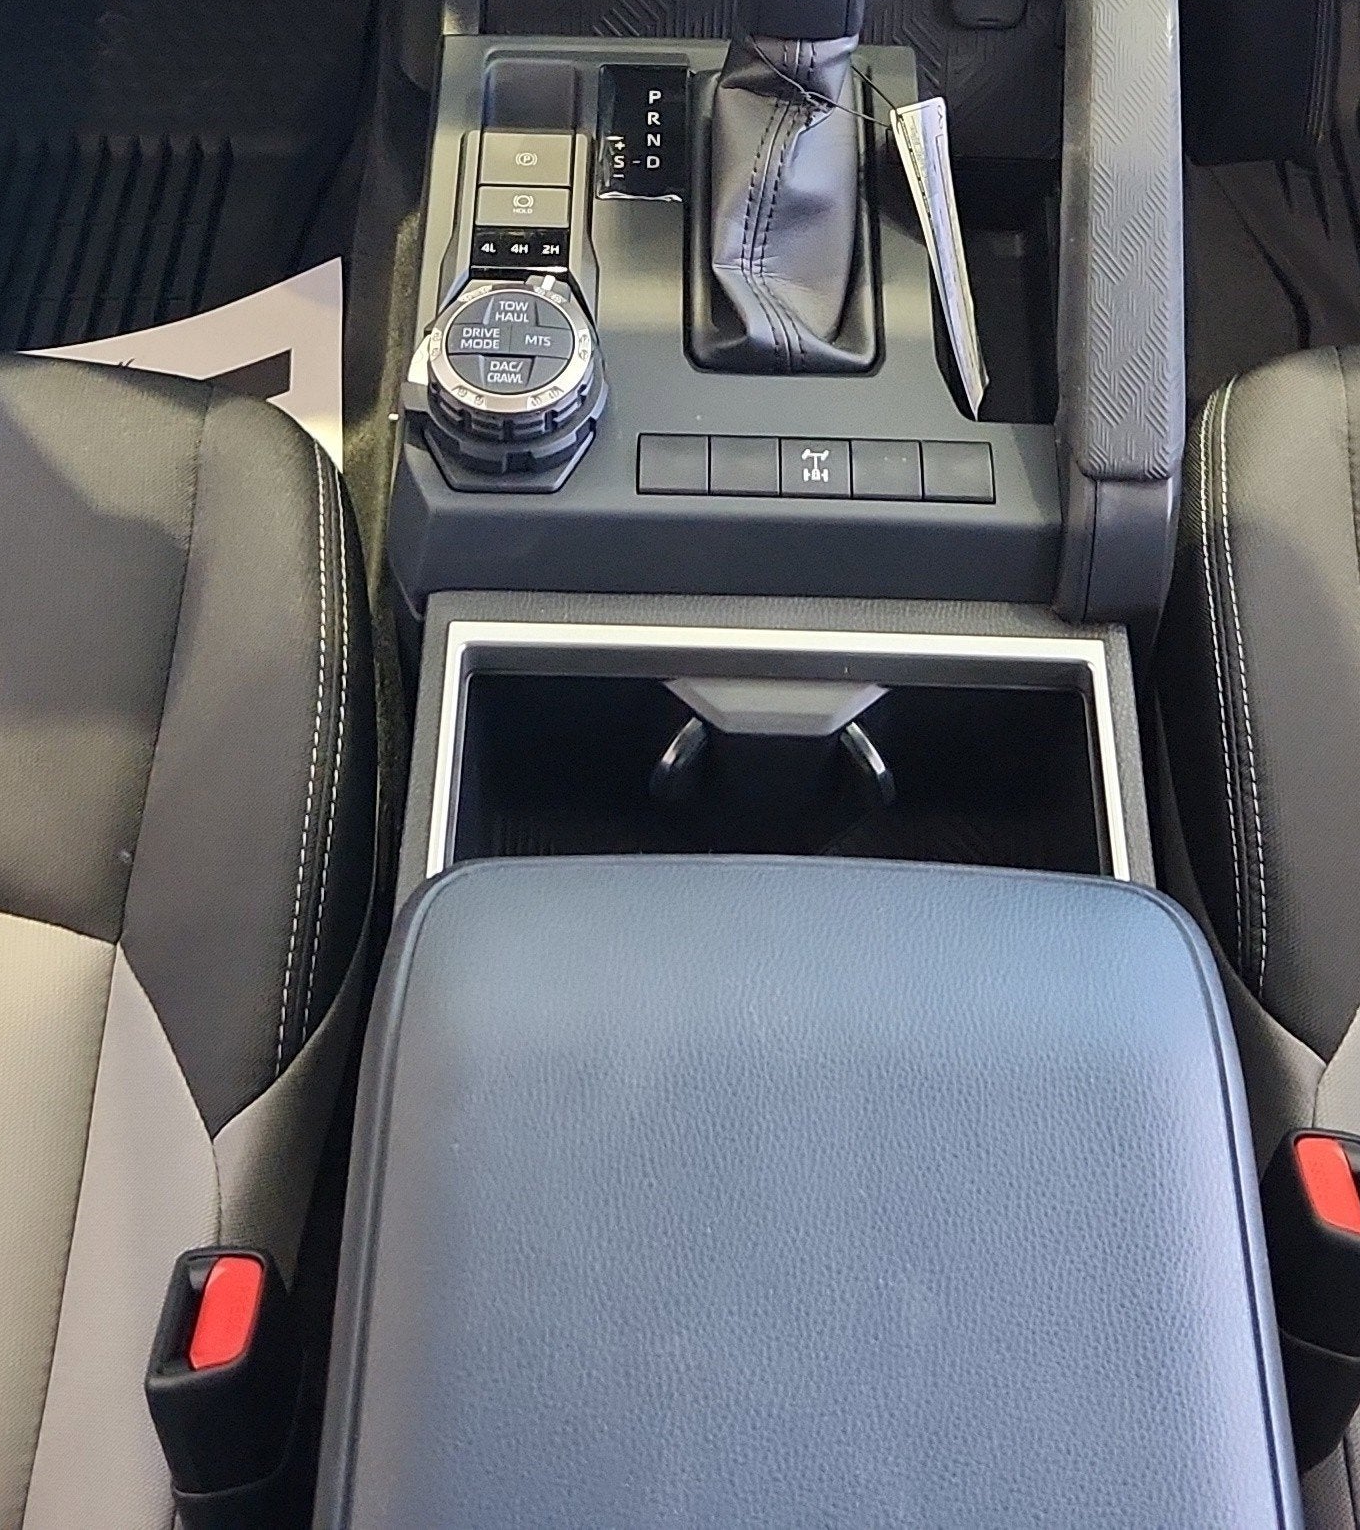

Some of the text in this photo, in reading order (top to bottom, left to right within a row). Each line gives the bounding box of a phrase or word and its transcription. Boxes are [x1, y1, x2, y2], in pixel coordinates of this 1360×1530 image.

[648, 90, 662, 105] P
[647, 111, 661, 126] R
[647, 133, 661, 147] N
[613, 155, 660, 169] S D
[512, 207, 533, 215] HOLD
[480, 243, 560, 255] 4L 4H 2H
[498, 301, 529, 312] TOW
[494, 311, 530, 323] HAUL
[462, 327, 500, 339] DRIVE
[460, 338, 500, 349] MODE
[524, 334, 551, 347] MTS
[489, 360, 523, 373] DAC/
[487, 372, 524, 384] CRAWL
